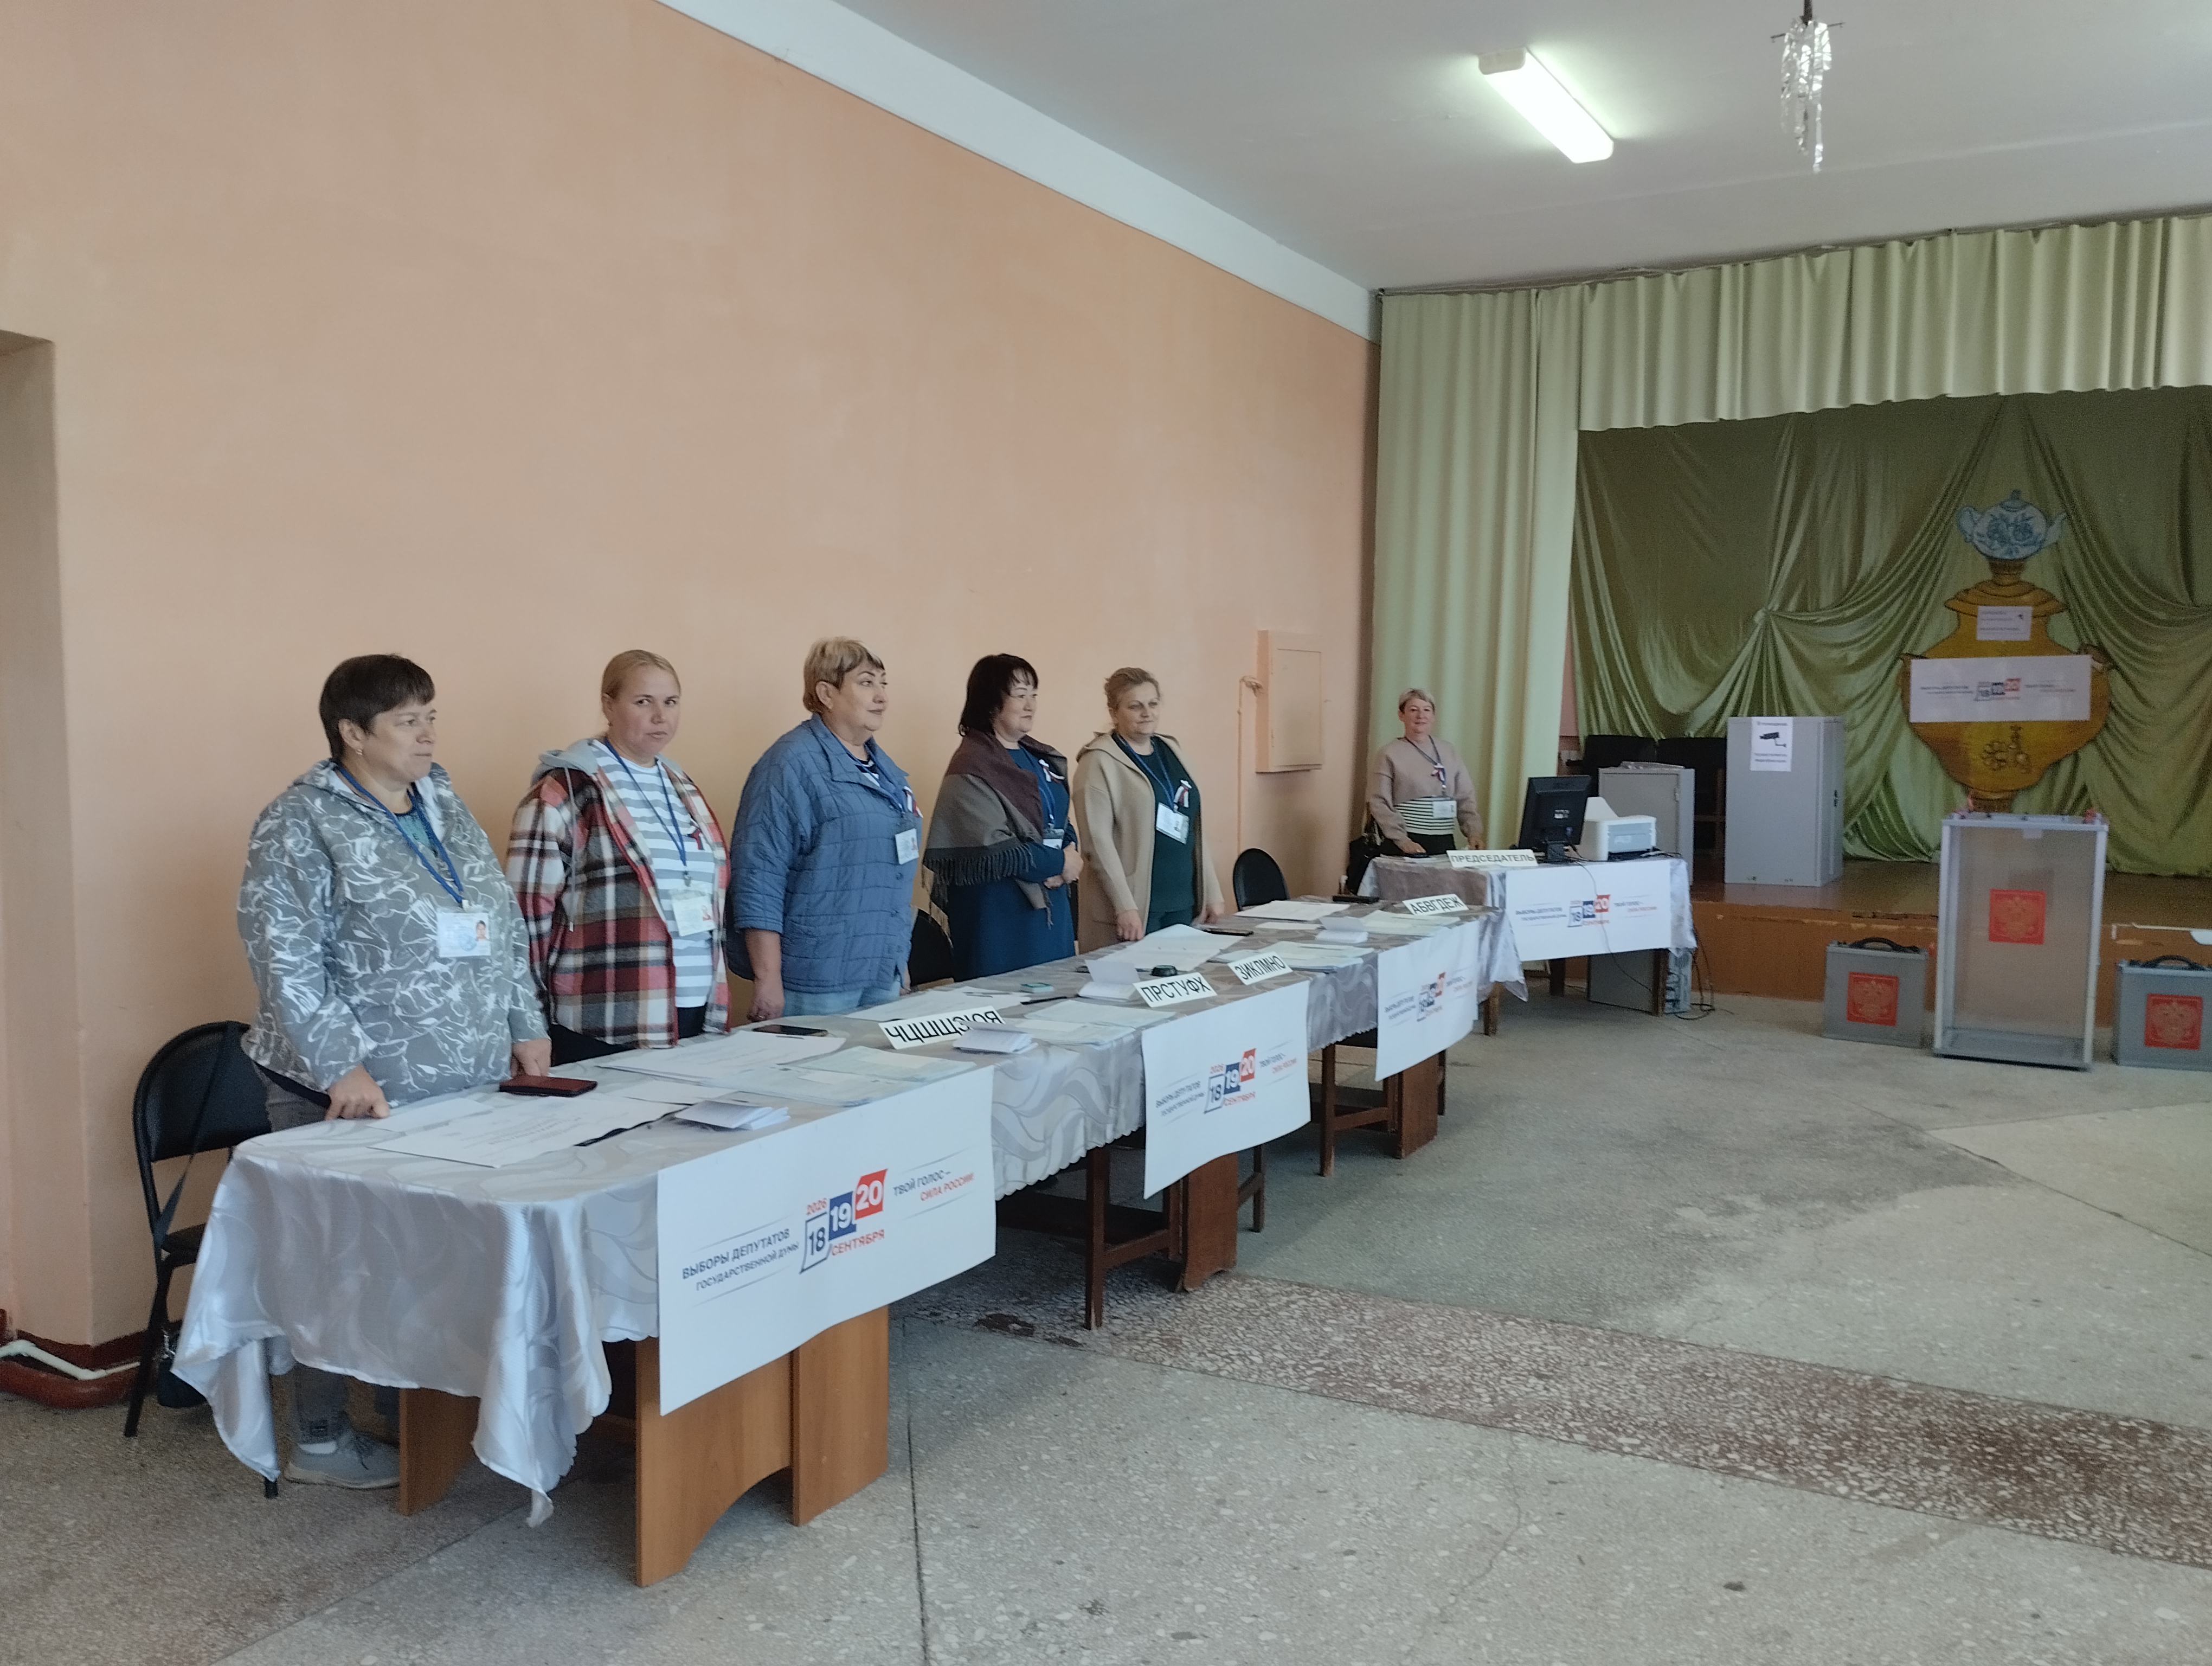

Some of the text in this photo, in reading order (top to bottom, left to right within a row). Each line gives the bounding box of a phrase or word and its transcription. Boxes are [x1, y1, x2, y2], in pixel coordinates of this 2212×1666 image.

[1450, 854, 1535, 863] ПРЕДСЕДАТЕЛЬ
[1410, 896, 1464, 914] АБВГДЕЖ
[1234, 954, 1287, 981] ЗИКЛМНО
[1140, 976, 1211, 1003] ПРСТУФХ
[1225, 1069, 1239, 1090] 19
[1240, 1055, 1255, 1077] 20
[1210, 1083, 1221, 1104] 18
[856, 1180, 883, 1211] 20
[893, 1178, 916, 1196] ТВОЙ
[830, 1202, 852, 1232] 19
[682, 1228, 790, 1279] ВЫБОРЫ ДЕПУТАТОВ
[809, 1226, 826, 1256] 18
[831, 1229, 885, 1256] СЕНТЯБРЯ
[696, 1250, 777, 1291] ГОСУДАРСТВЕННОЙ
